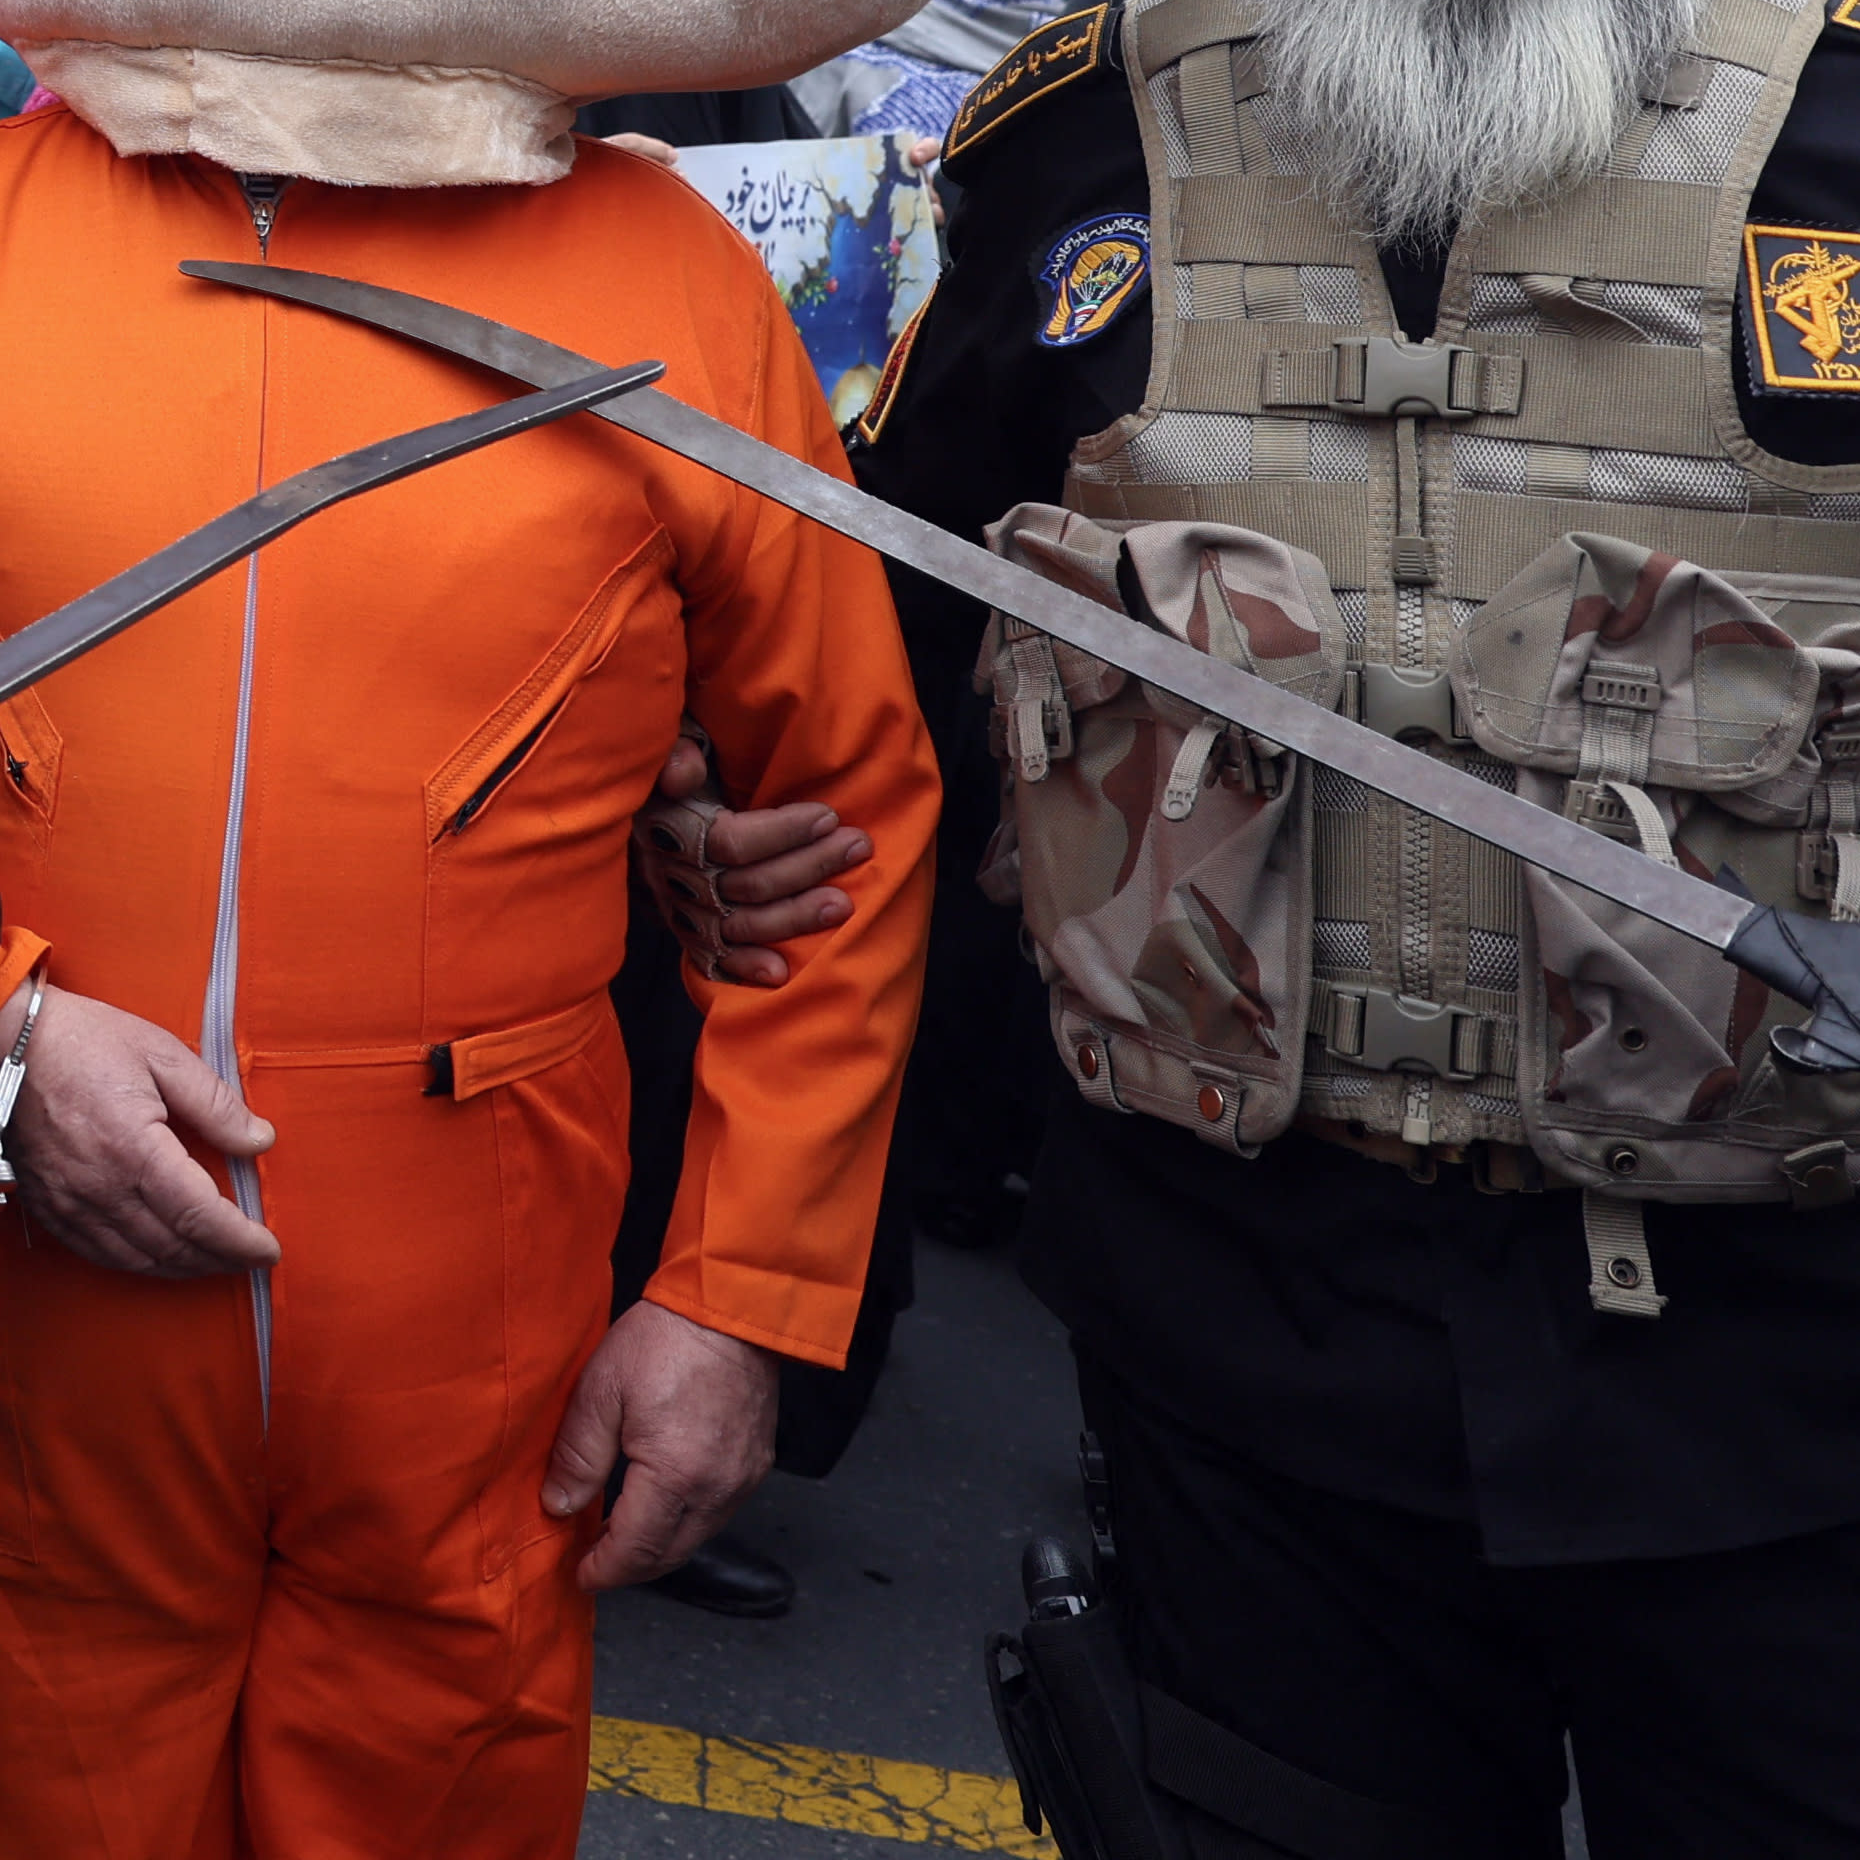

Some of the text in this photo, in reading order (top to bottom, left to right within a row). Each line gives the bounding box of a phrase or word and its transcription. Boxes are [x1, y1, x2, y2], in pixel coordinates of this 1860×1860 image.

[1027, 50, 1042, 77] یا
[1044, 21, 1094, 64] لبیک
[725, 164, 756, 214] خود
